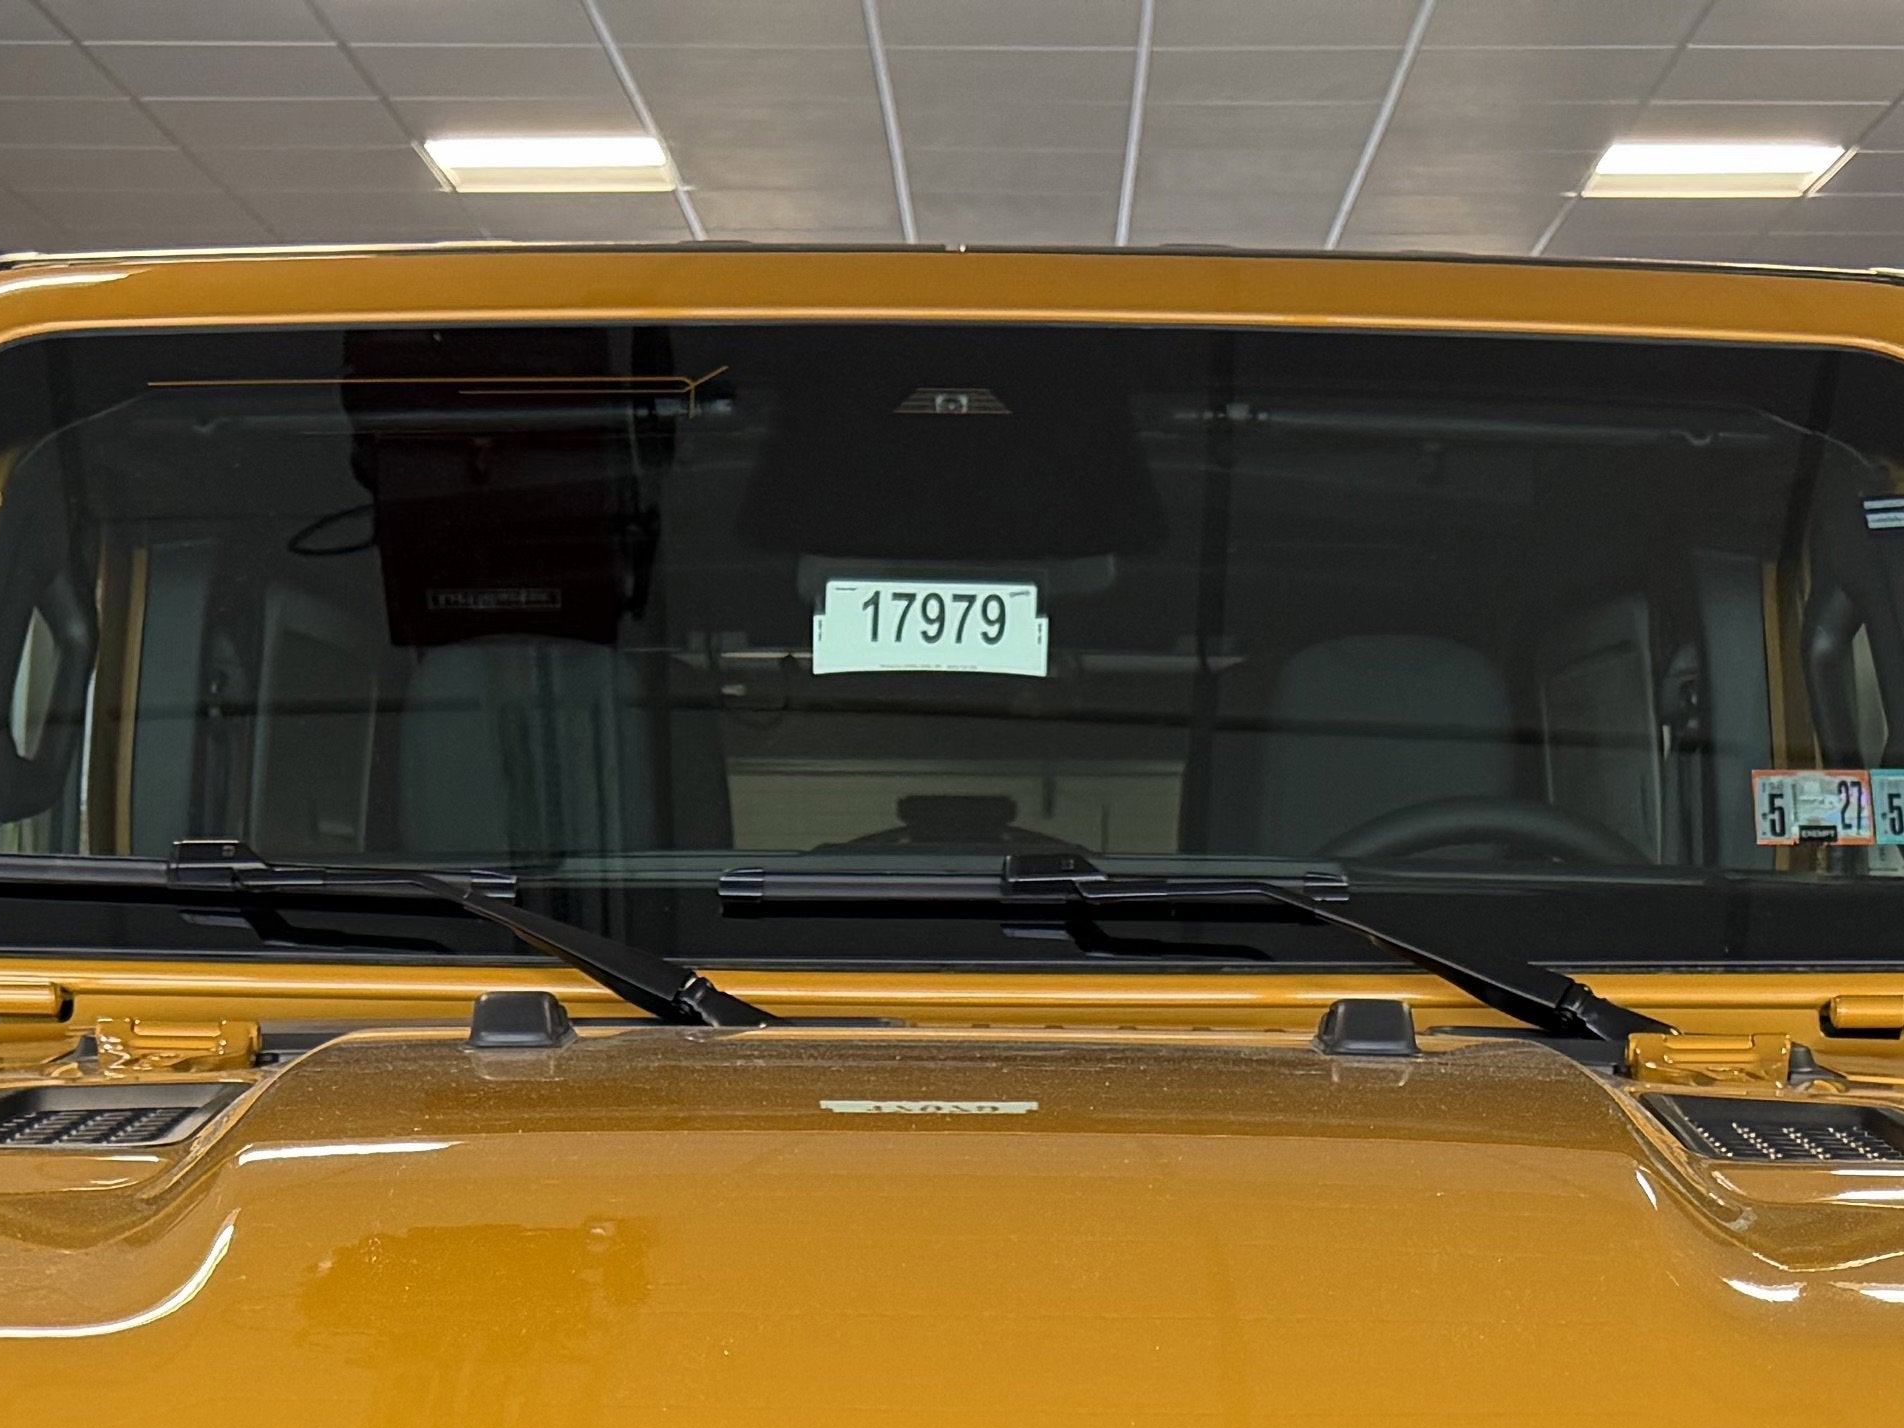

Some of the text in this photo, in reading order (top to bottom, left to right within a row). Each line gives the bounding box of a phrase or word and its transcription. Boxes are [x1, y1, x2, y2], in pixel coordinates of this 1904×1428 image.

[862, 590, 1007, 645] 17979
[1768, 780, 1863, 837] 5 27
[1887, 792, 1904, 836] 5
